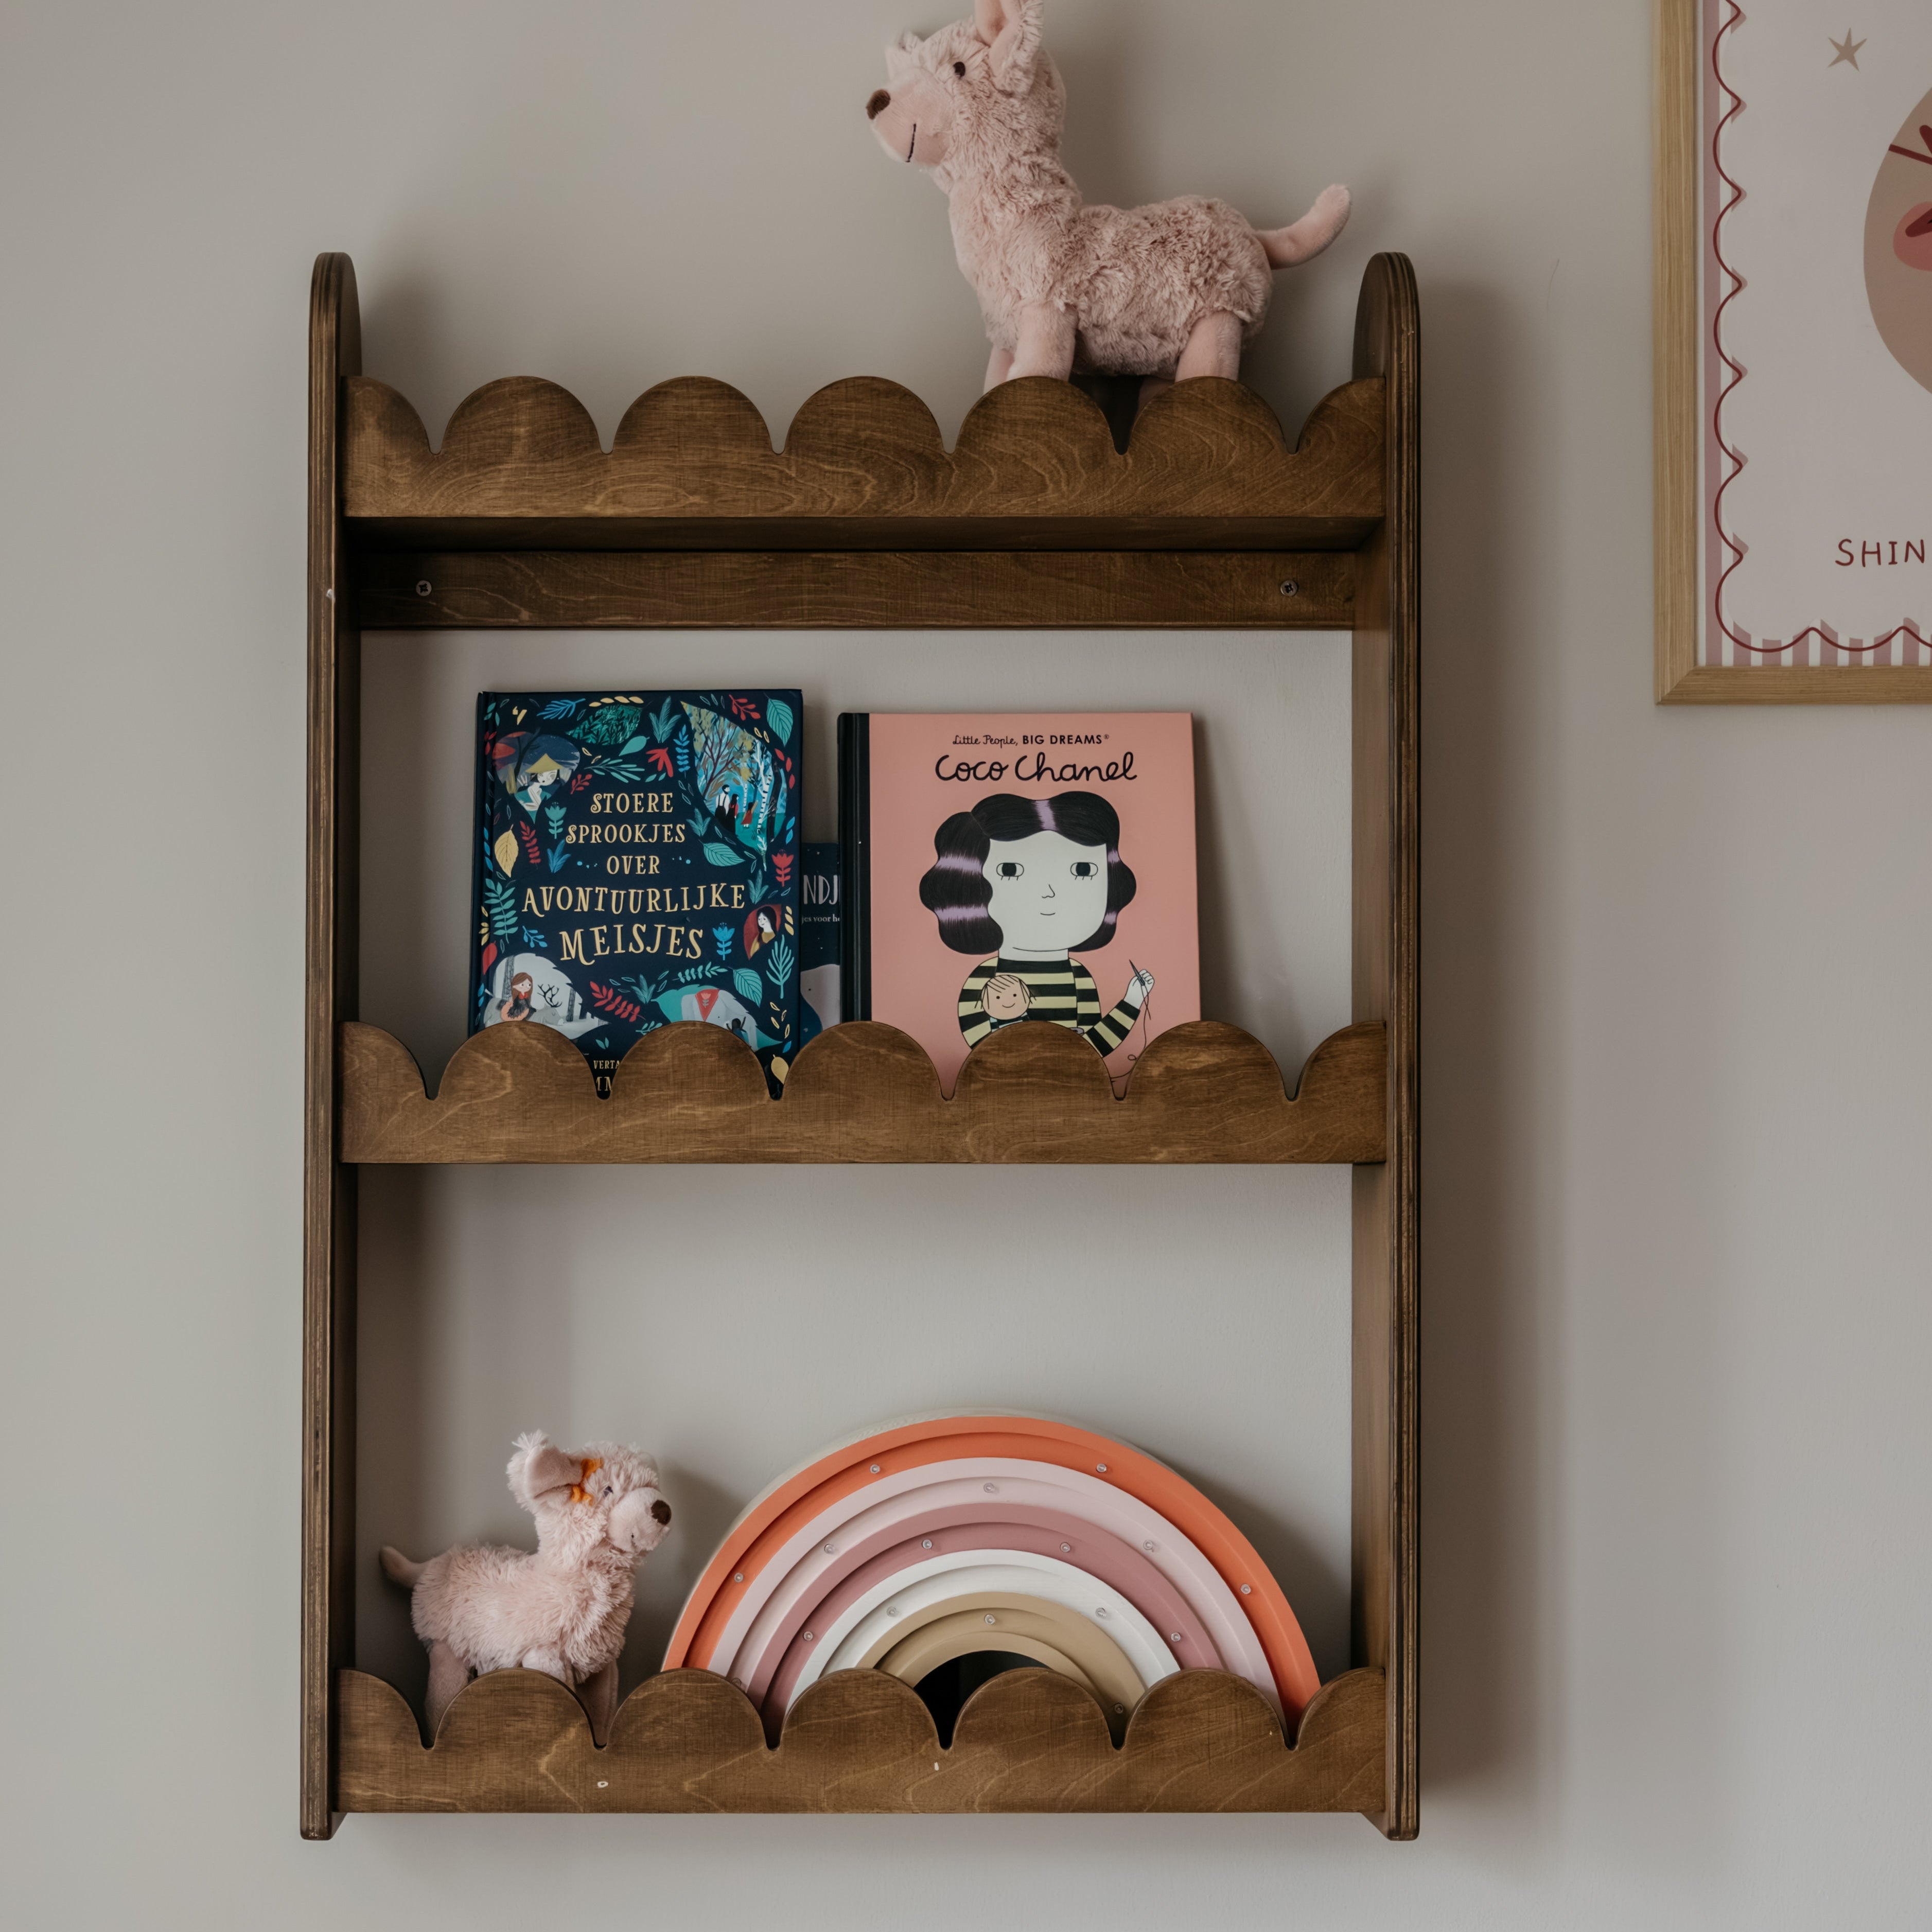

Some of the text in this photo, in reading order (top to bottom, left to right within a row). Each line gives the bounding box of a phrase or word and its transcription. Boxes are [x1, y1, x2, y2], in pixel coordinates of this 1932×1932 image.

[1834, 538, 1925, 568] SHIN
[952, 734, 981, 745] Little
[982, 734, 1018, 748] People,
[1022, 734, 1045, 745] BIG
[935, 751, 1137, 782] Coco Chanel
[590, 792, 674, 814] STOERE
[566, 823, 686, 844] SPROOKJES
[606, 855, 660, 875] OVER
[521, 883, 746, 918] AVONTUURLIJKE
[558, 923, 704, 966] MEISJES
